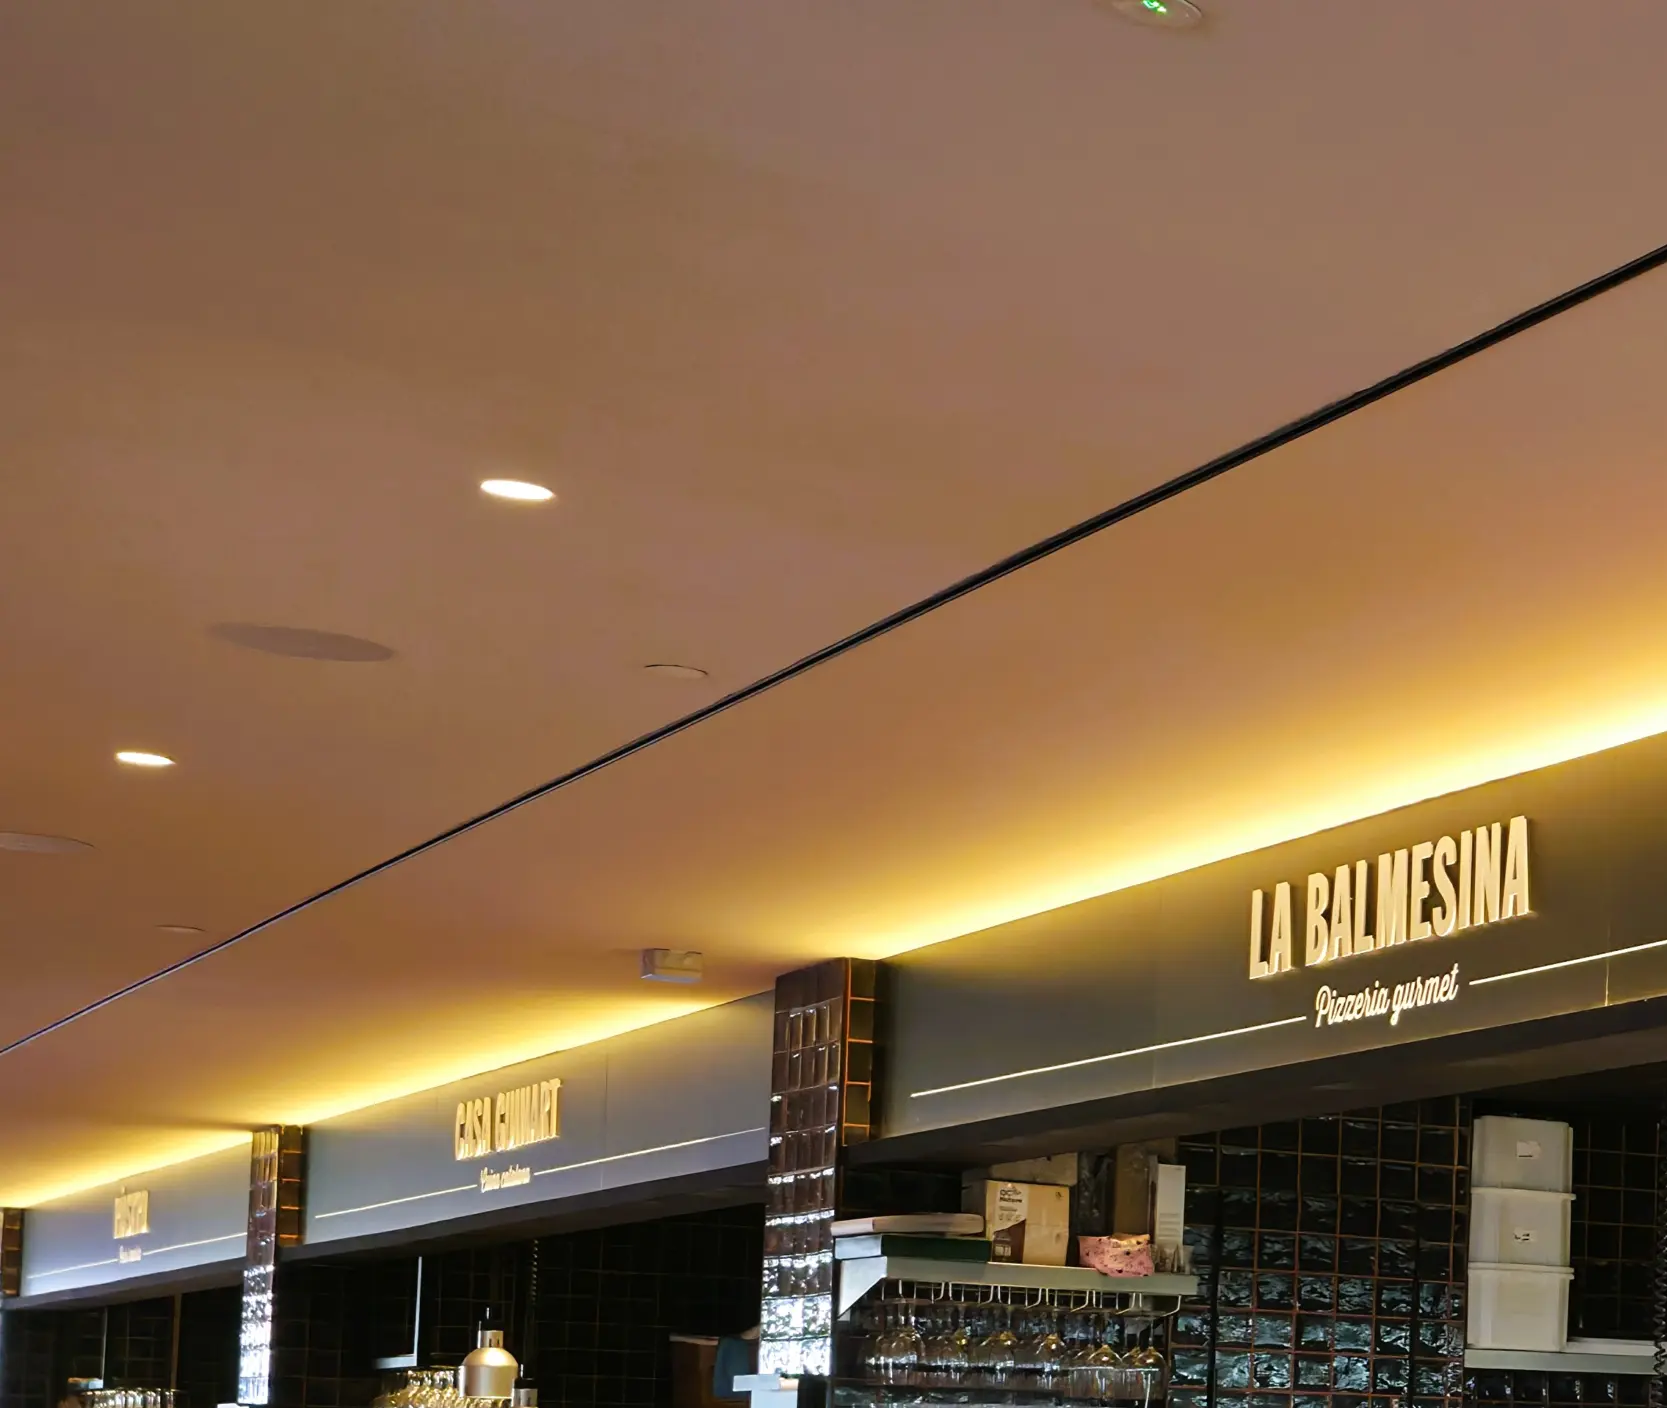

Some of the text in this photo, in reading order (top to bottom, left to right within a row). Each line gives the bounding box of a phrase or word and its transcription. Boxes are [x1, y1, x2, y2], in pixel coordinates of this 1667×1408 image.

[1250, 815, 1531, 979] LA BALMESINA
[1315, 963, 1459, 1028] Pizzeria gurmet
[455, 1097, 491, 1160] CASA
